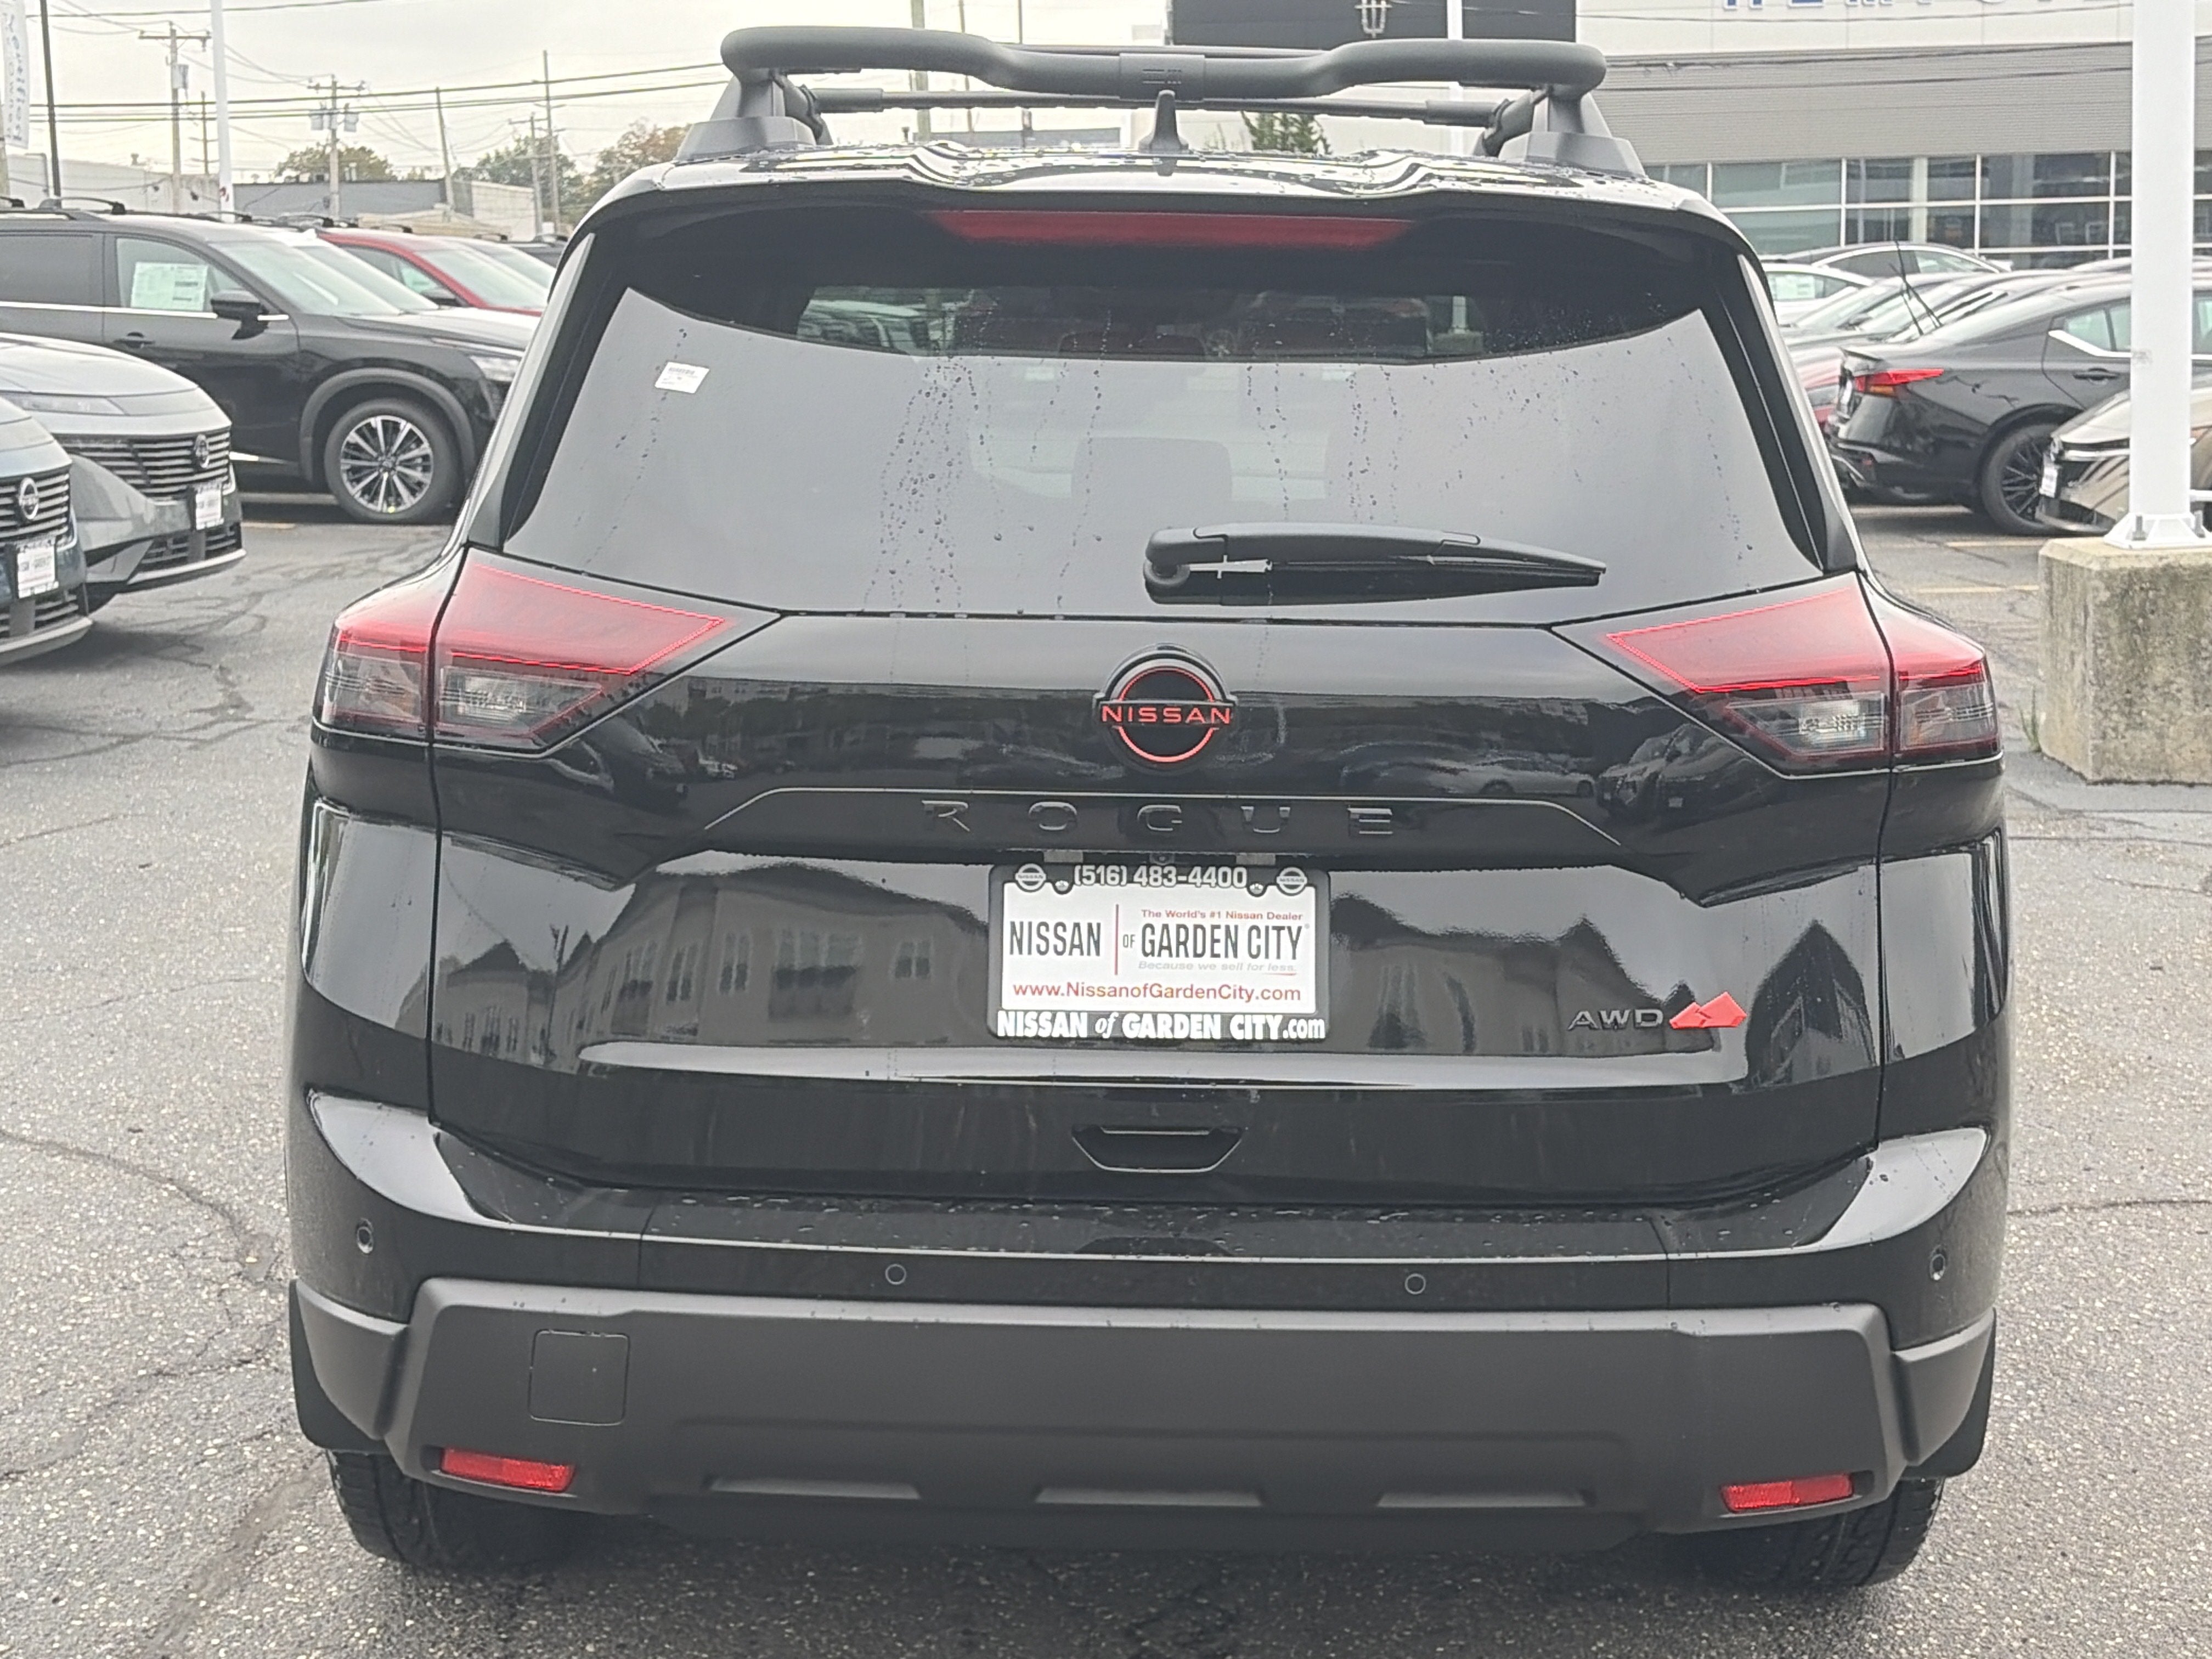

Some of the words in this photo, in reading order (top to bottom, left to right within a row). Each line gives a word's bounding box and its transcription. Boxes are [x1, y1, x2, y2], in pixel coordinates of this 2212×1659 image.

[1102, 706, 1231, 724] NISSAN
[921, 799, 1393, 835] ROGUE
[1074, 865, 1127, 885] (516)
[1133, 865, 1248, 888] 483-4400
[1142, 910, 1161, 918] The
[1165, 910, 1206, 919] World's
[1226, 911, 1263, 920] Nissan
[1267, 912, 1304, 921] Dealer
[1009, 921, 1101, 957] NISSAN
[1122, 934, 1136, 948] OF
[1142, 923, 1239, 958] GARDEN
[1248, 925, 1302, 960] CITY
[1138, 961, 1194, 970] Because
[1221, 962, 1244, 971] sell
[1247, 963, 1264, 971] for
[1267, 963, 1297, 972] less.
[1013, 982, 1301, 1003] www.NissanofGardenCity.com
[997, 1011, 1088, 1038] NISSAN
[1096, 1012, 1119, 1039] of
[1122, 1012, 1221, 1039] GARDEN
[1230, 1014, 1326, 1041] CITY.com
[1567, 1009, 1664, 1030] AWD
